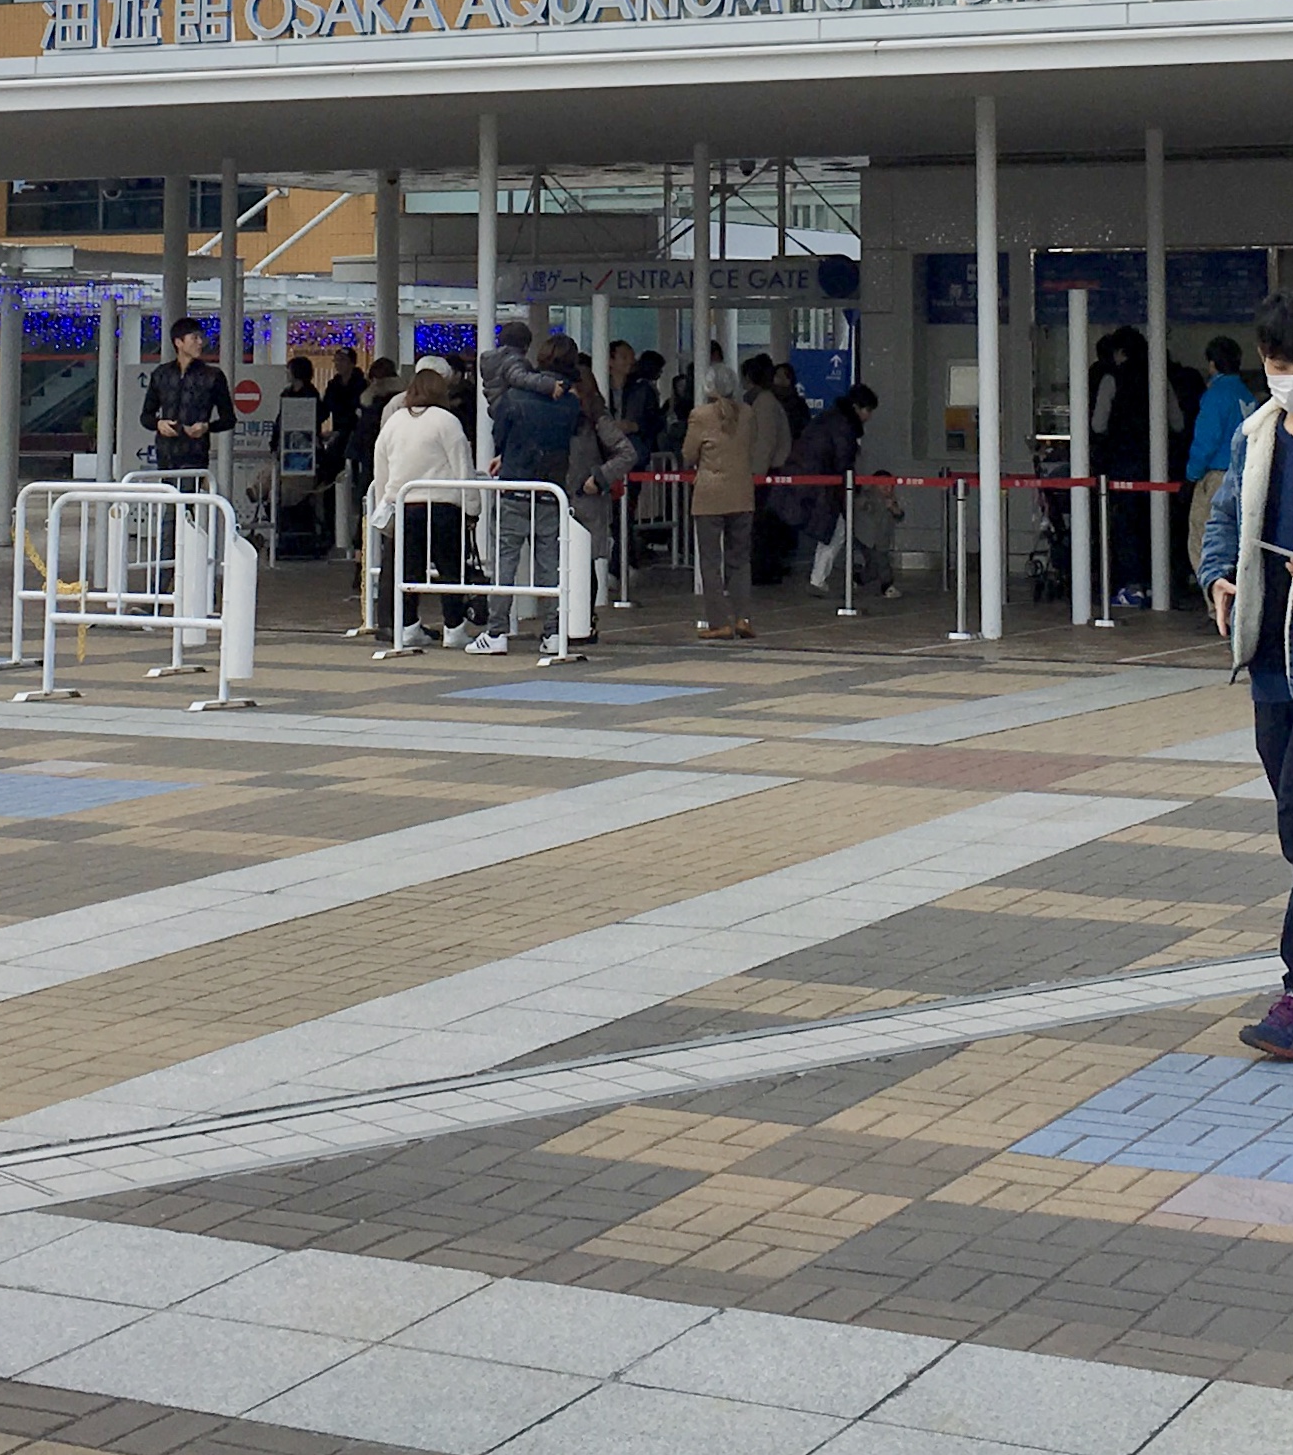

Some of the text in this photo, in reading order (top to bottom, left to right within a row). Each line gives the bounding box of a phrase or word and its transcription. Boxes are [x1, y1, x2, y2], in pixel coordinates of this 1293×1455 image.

[748, 269, 810, 289] GATE
[234, 420, 275, 436] 口専用
